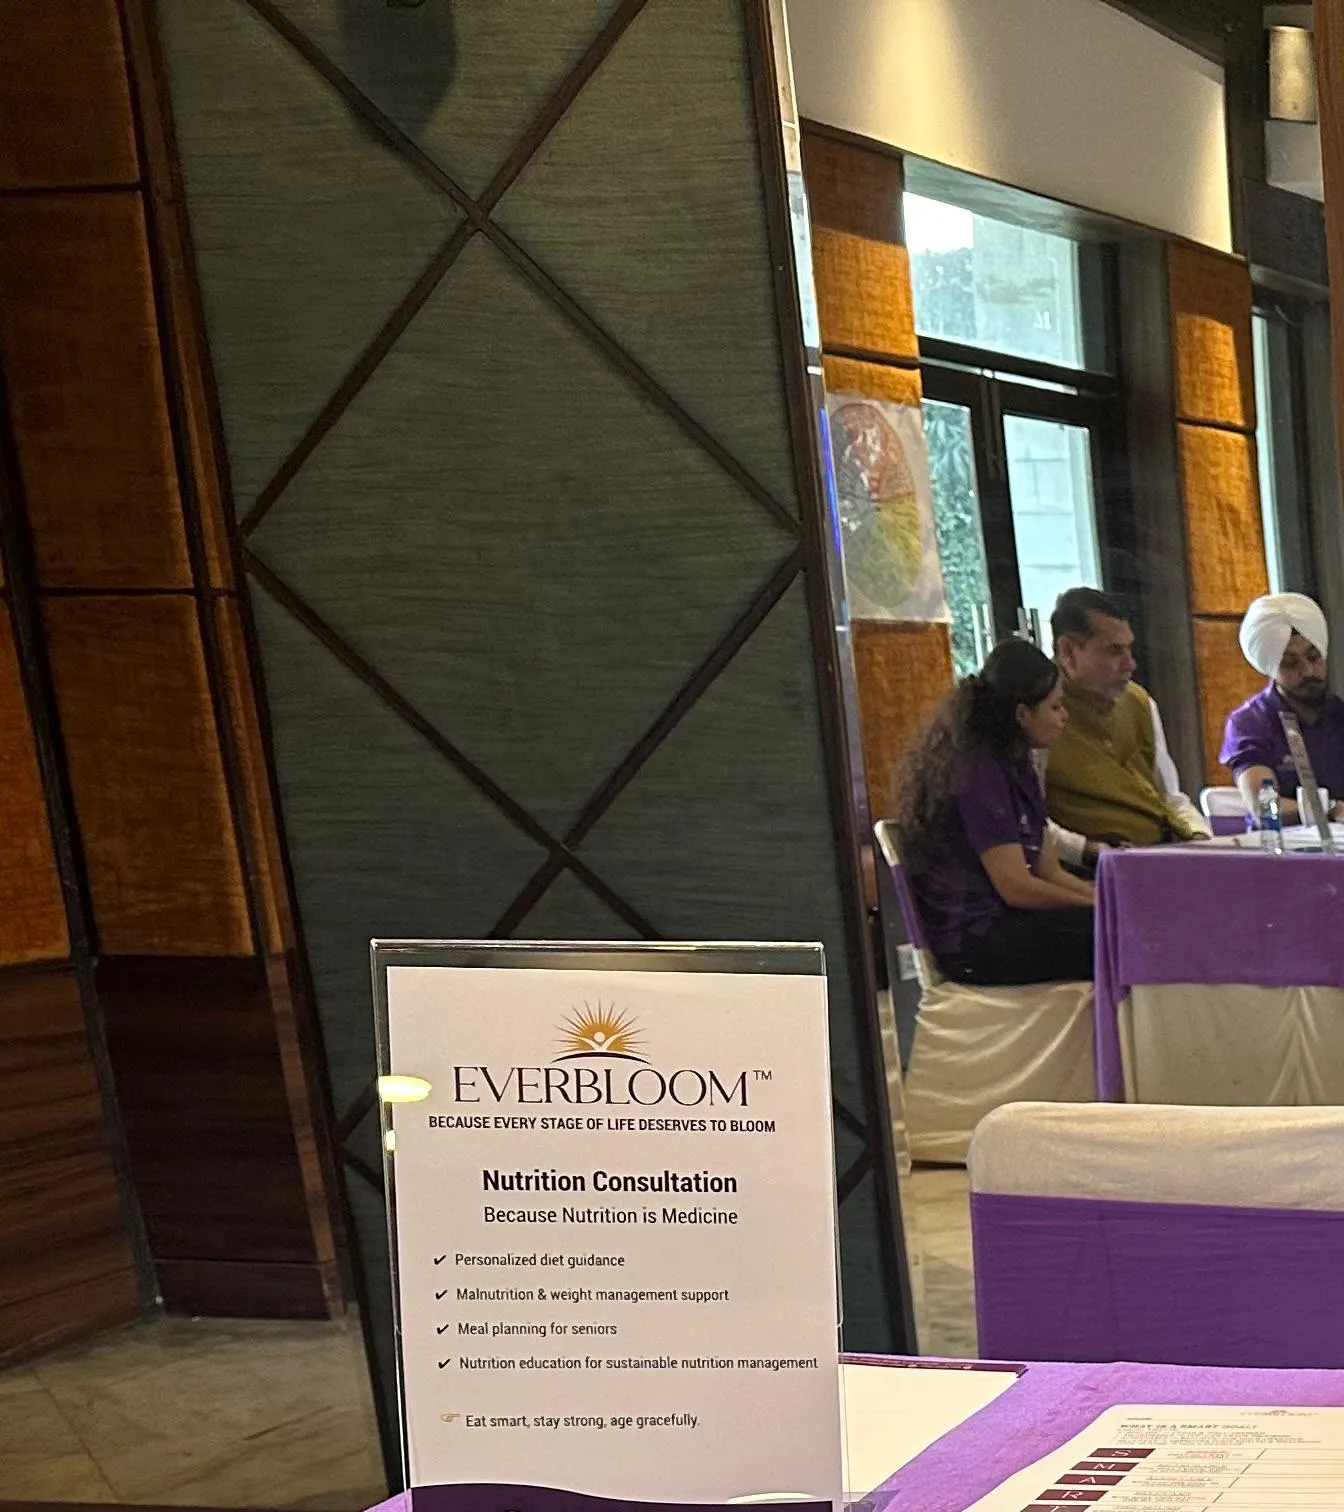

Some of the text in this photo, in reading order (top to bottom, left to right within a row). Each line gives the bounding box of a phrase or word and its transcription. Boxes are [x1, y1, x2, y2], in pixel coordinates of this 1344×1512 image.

[429, 1116, 775, 1132] BECAUSE EVERY STAGE OF LIFE DESERVES TO BLOOM
[483, 1169, 737, 1192] Nutrition Consultation
[485, 1207, 737, 1224] Because Nutrition is Medicine
[456, 1254, 624, 1269] Personalized diet guidance
[457, 1288, 729, 1303] Malnutrition & weight management support
[459, 1322, 617, 1337] Meal planning for seniors
[460, 1356, 818, 1371] Nutrition education for sustainable nutrition management
[466, 1414, 701, 1429] Eat smart, stay strong, age gracefully.
